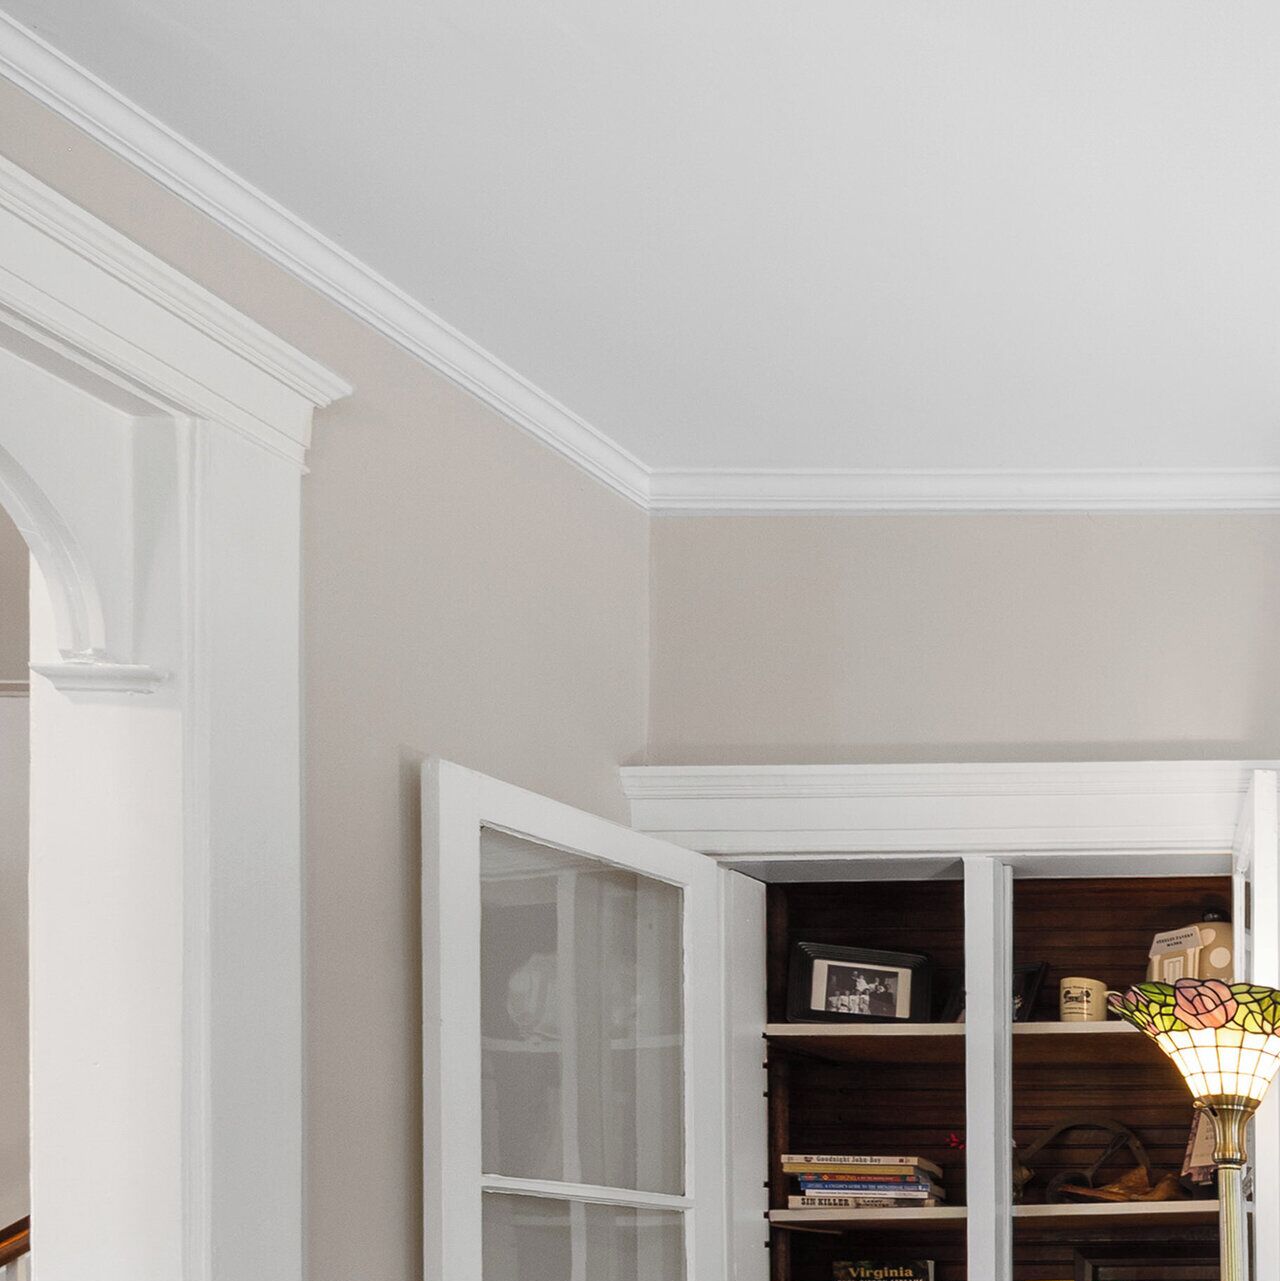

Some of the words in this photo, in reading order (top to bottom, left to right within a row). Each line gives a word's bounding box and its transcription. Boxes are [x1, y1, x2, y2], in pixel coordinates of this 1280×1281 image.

[816, 1156, 850, 1164] Goodnight
[801, 1198, 816, 1206] SIN
[818, 1198, 850, 1207] KILLER
[848, 1267, 913, 1279] Virginia
